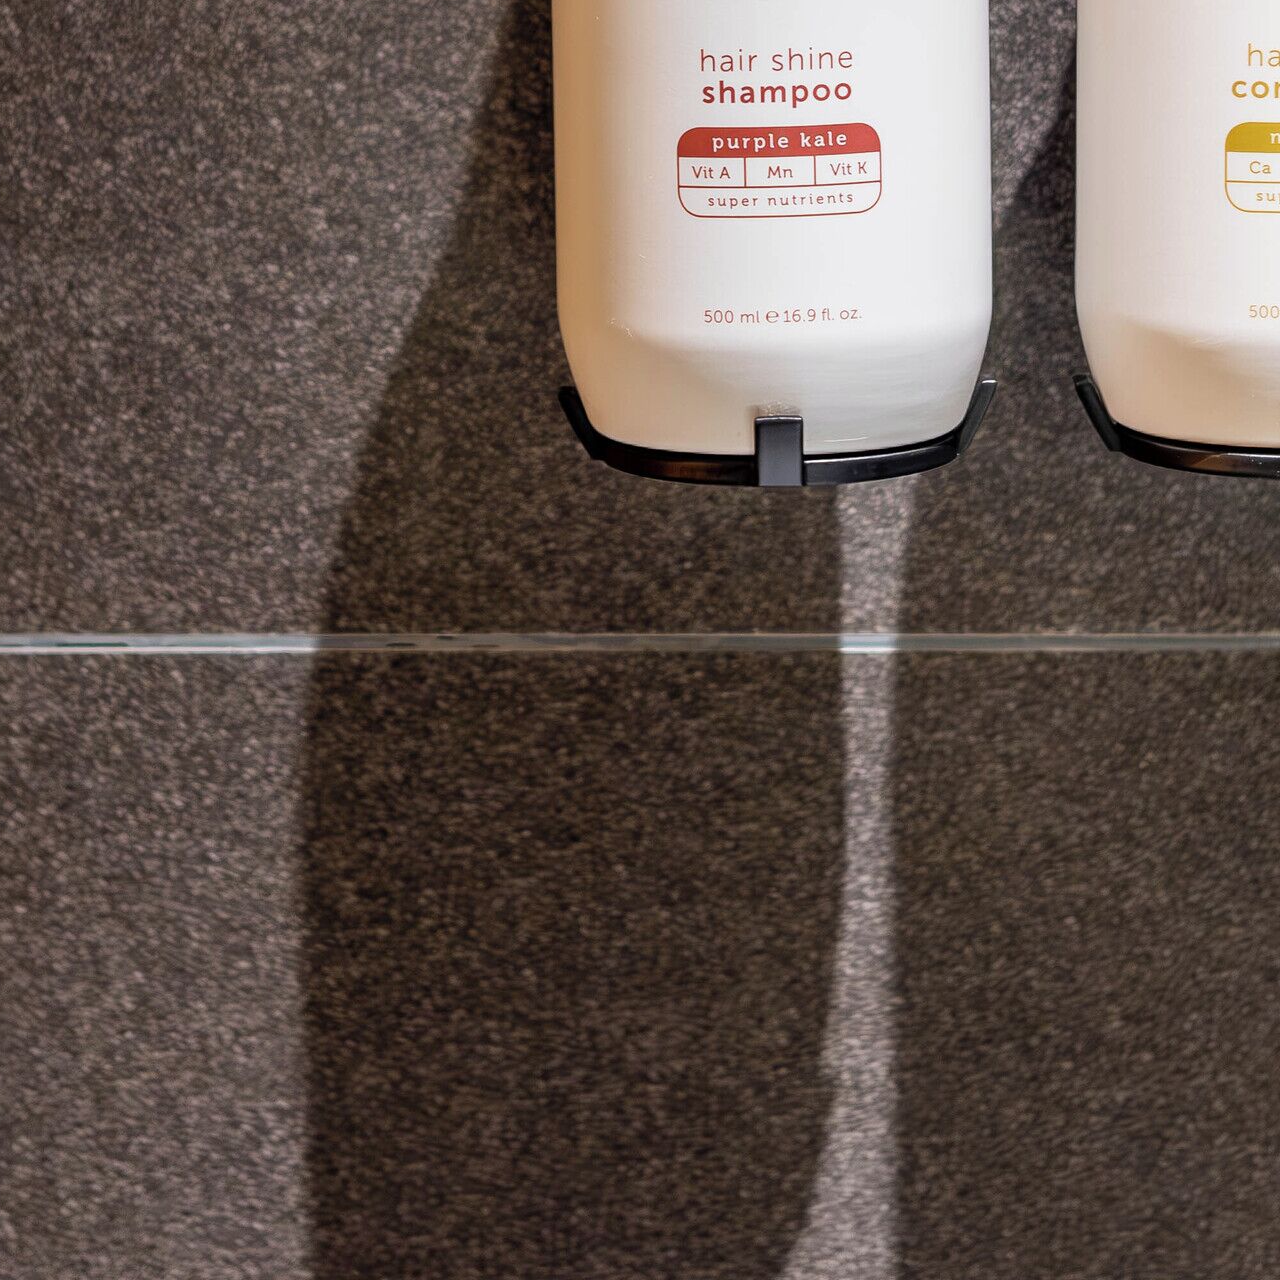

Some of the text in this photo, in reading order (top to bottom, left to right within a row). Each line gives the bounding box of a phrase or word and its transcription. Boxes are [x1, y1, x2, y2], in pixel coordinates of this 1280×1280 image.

[699, 47, 854, 72] hair shine
[702, 80, 852, 108] shampoo
[712, 131, 848, 152] purple kale
[692, 166, 731, 180] Vit A
[766, 166, 794, 179] Mn
[830, 162, 868, 176] Vit K
[1248, 160, 1272, 174] Ca
[708, 192, 854, 208] super nutrients
[704, 310, 734, 324] 500
[740, 310, 760, 324] ml
[783, 308, 816, 323] 16.9
[1248, 304, 1280, 319] 500
